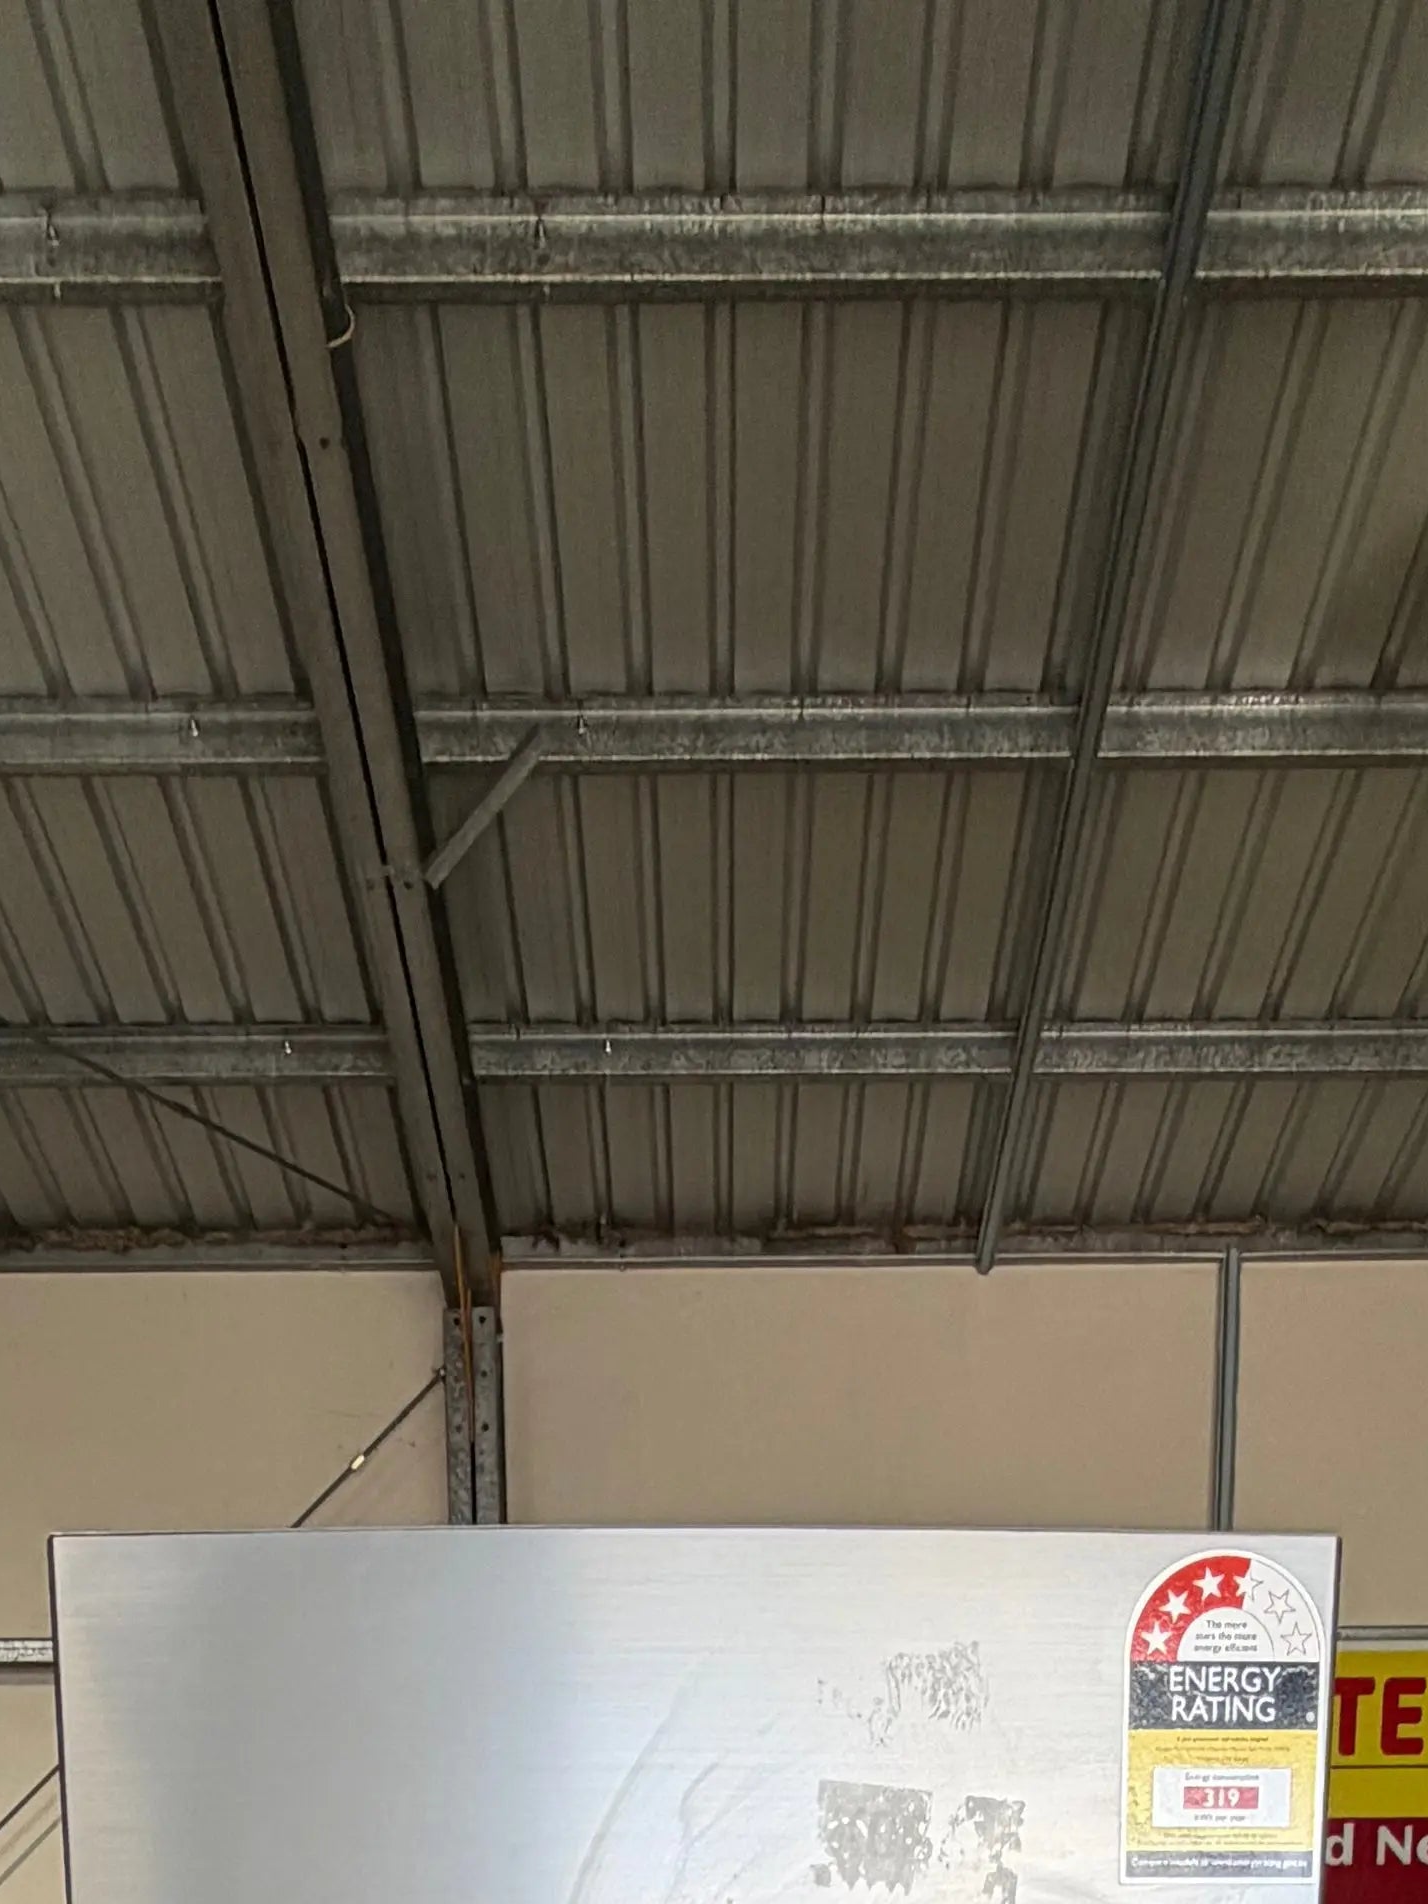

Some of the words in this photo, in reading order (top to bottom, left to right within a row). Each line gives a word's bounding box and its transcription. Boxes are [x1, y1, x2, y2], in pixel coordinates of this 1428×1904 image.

[1169, 1665, 1281, 1692] ENERGY
[1172, 1696, 1276, 1722] RATING
[1202, 1787, 1241, 1809] 319
